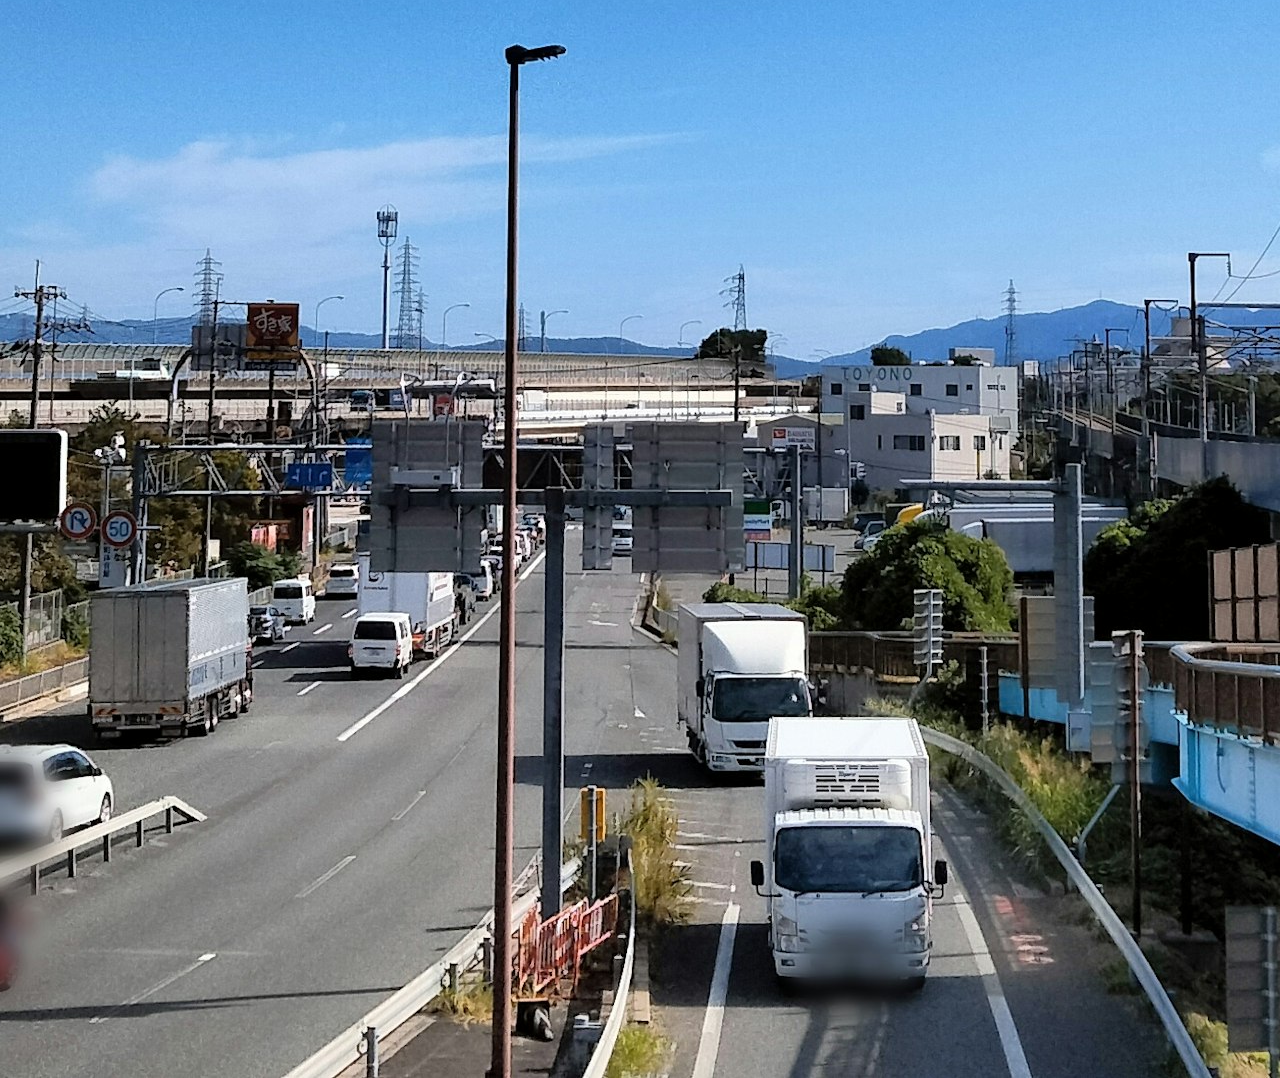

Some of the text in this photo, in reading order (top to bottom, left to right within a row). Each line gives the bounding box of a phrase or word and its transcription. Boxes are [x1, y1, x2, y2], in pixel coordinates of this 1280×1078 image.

[253, 307, 293, 335] すき家
[841, 367, 913, 381] TOYONO
[108, 521, 129, 537] 50
